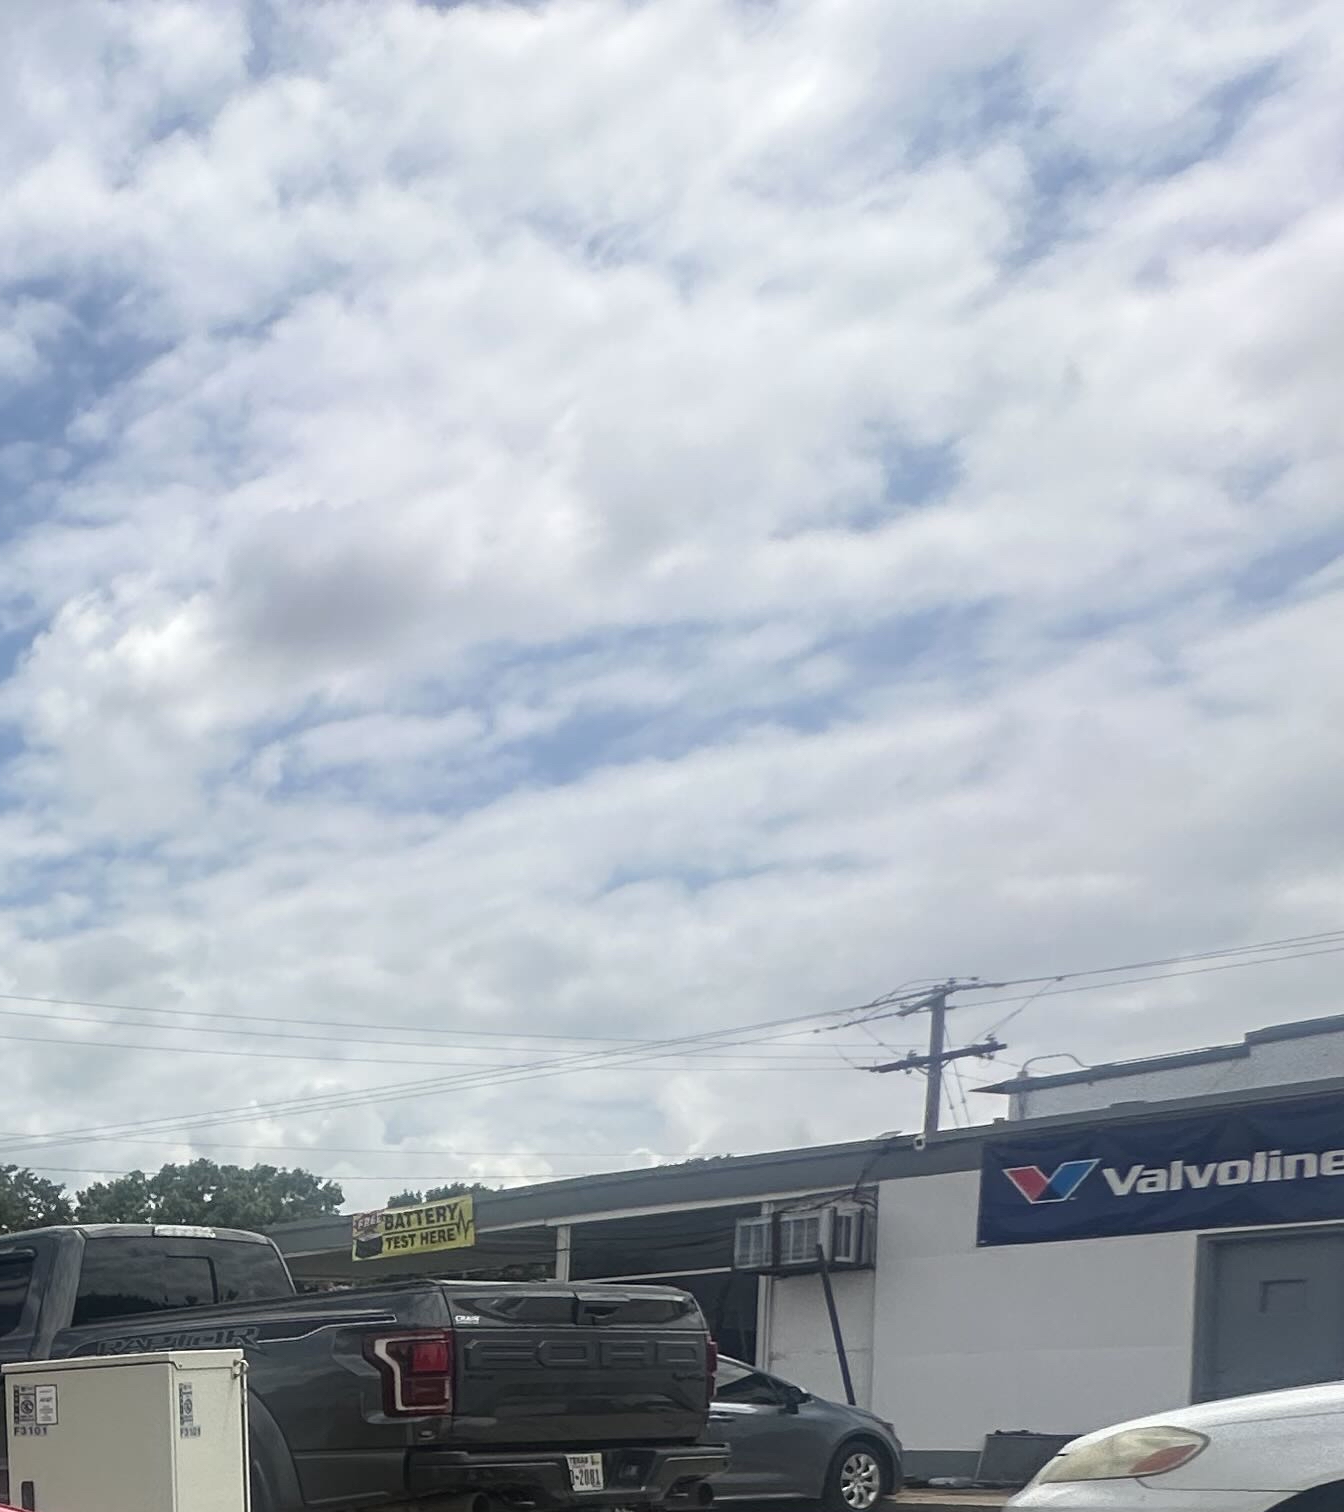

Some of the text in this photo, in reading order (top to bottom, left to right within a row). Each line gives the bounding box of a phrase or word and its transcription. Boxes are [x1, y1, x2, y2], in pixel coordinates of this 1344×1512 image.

[1102, 1149, 1344, 1196] Valvoline
[384, 1202, 459, 1231] BATTERY
[385, 1228, 456, 1250] TEST HERE
[464, 1339, 702, 1370] FORD
[14, 1426, 47, 1436] F3101
